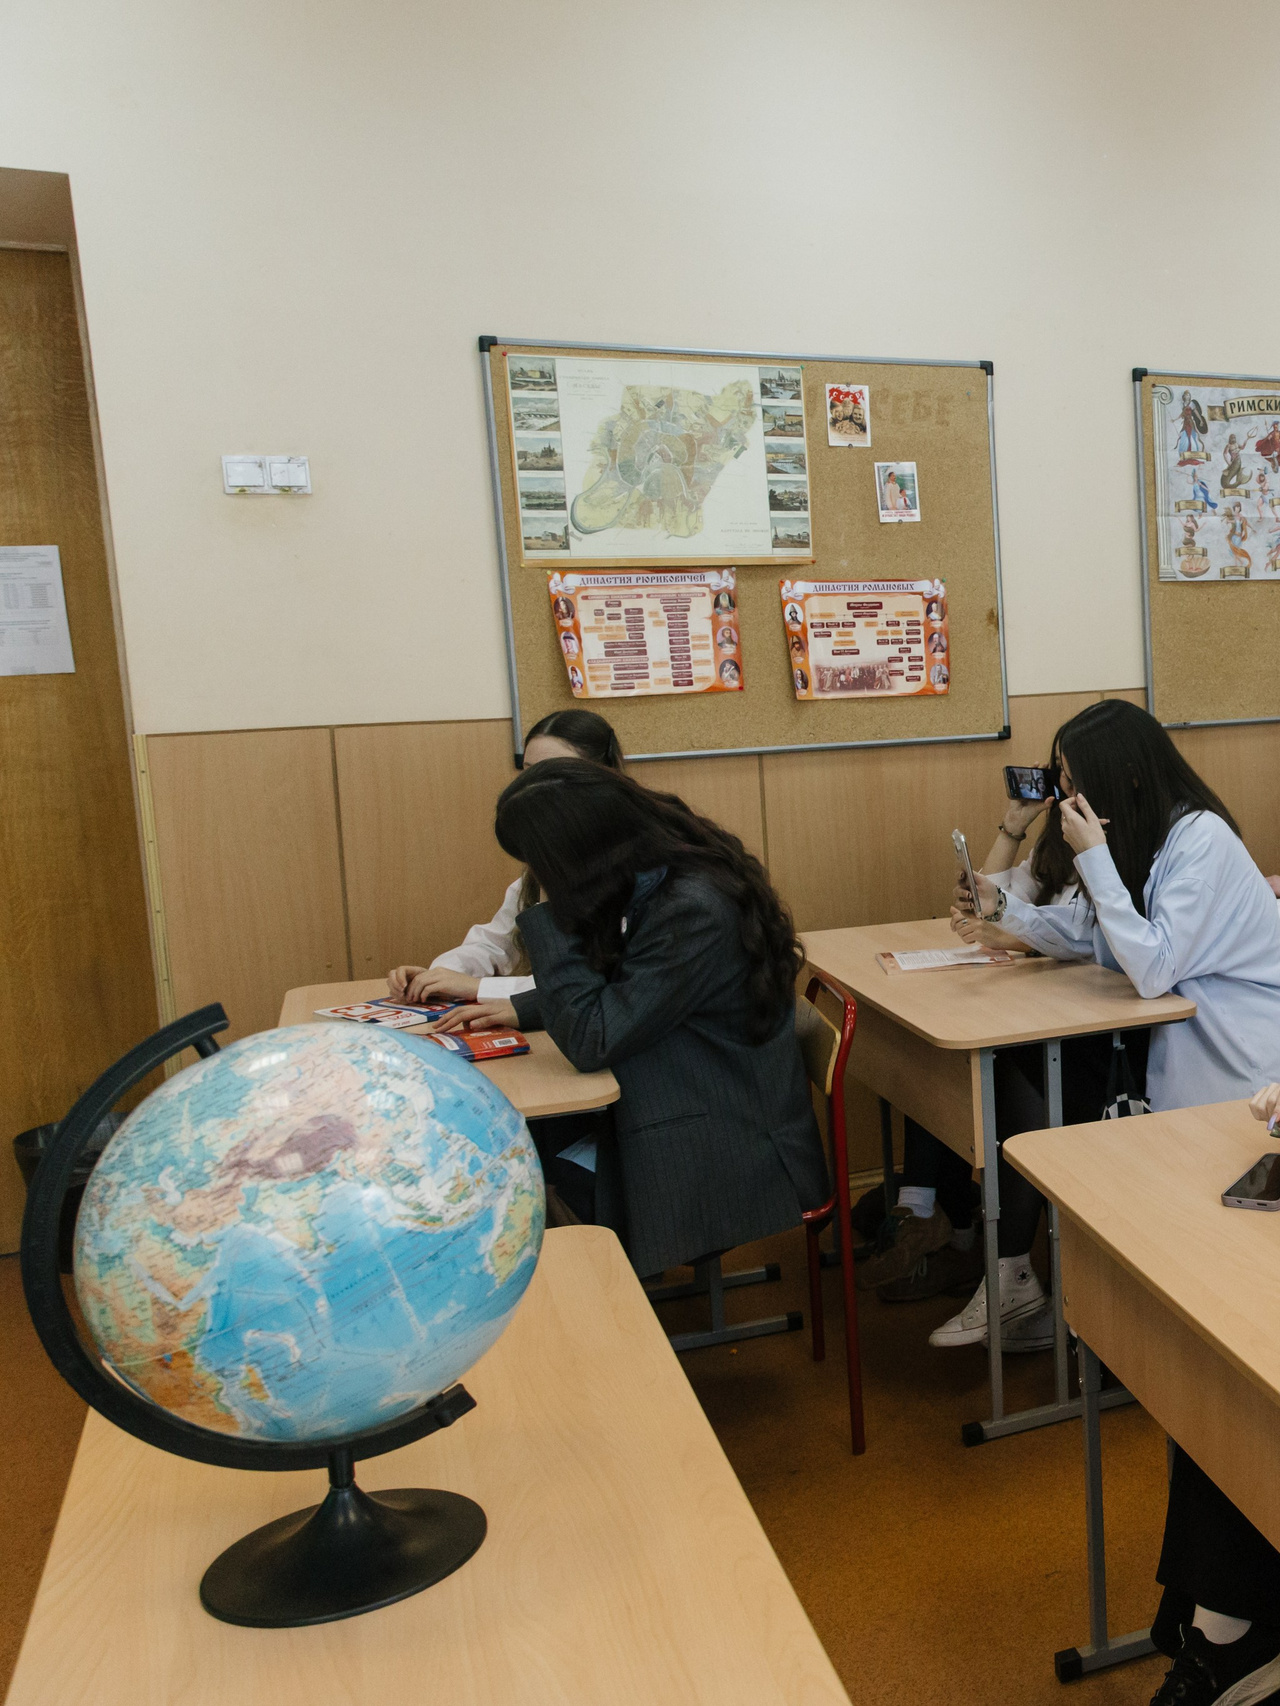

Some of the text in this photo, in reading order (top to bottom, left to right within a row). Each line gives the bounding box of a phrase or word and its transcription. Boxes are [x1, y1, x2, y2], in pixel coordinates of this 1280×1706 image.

[580, 573, 706, 586] ДИНАСТИЯ РЮРИКОВИЧЕЙ
[813, 583, 915, 592] ДИНАСТИЯ РОМАНОВЫХ
